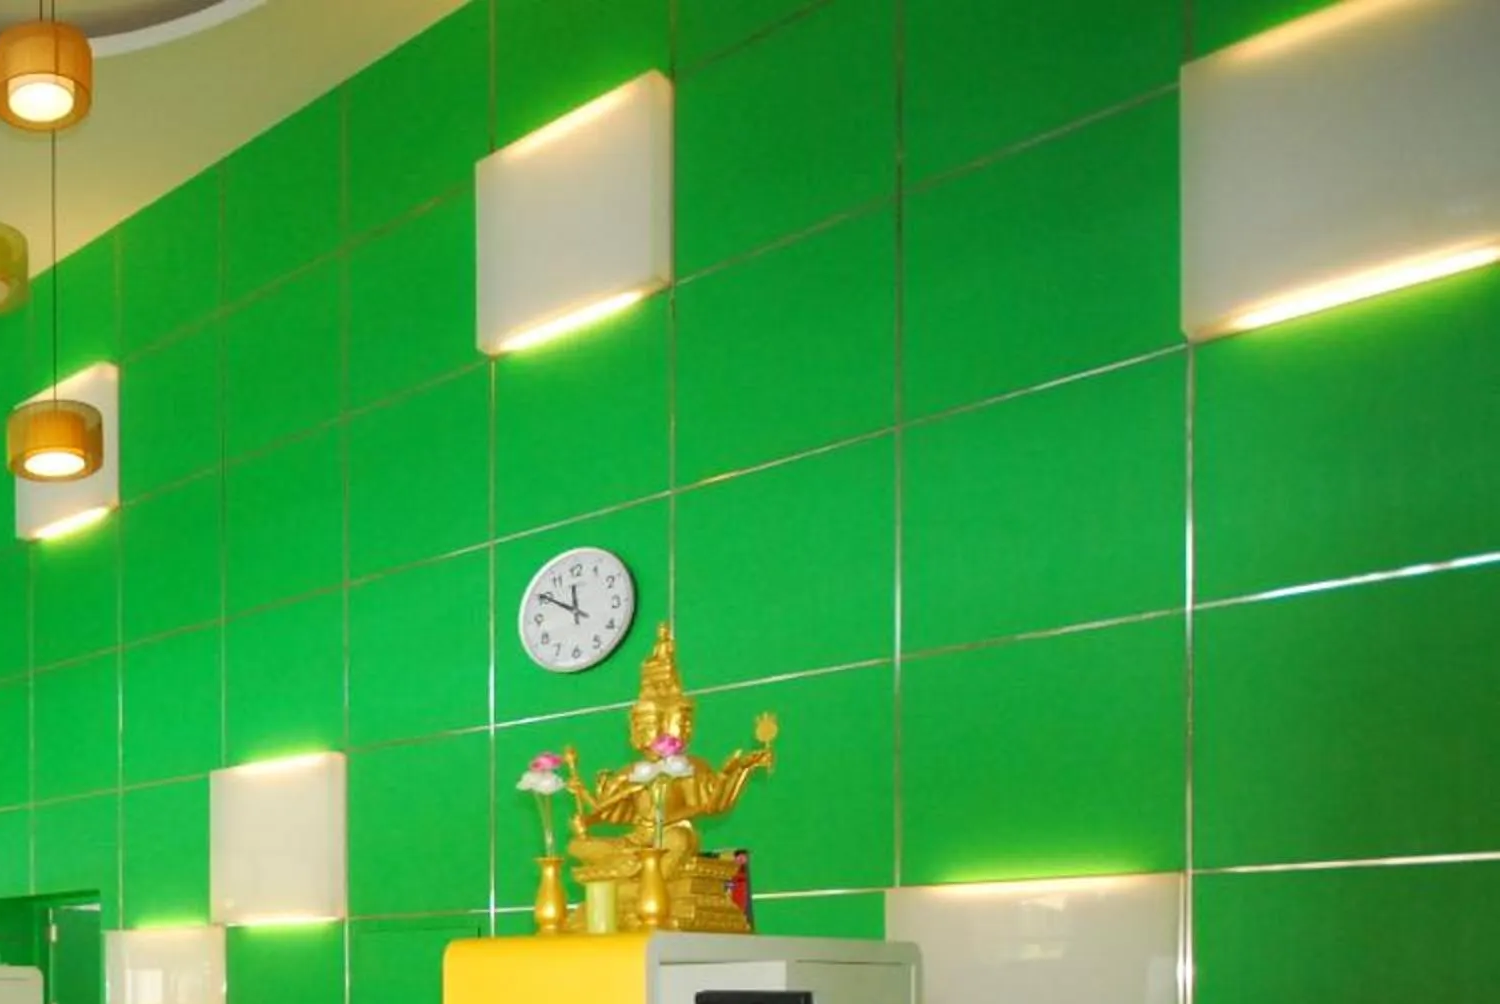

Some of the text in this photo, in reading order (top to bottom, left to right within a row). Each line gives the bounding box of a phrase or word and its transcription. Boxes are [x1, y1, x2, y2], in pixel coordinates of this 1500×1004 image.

[569, 564, 583, 577] 12
[606, 575, 615, 589] 2
[611, 594, 621, 609] 3
[534, 614, 544, 626] 9
[605, 618, 615, 630] 4
[541, 632, 549, 645] 8
[592, 634, 601, 650] 5
[554, 643, 561, 657] 7
[571, 645, 581, 659] 6
